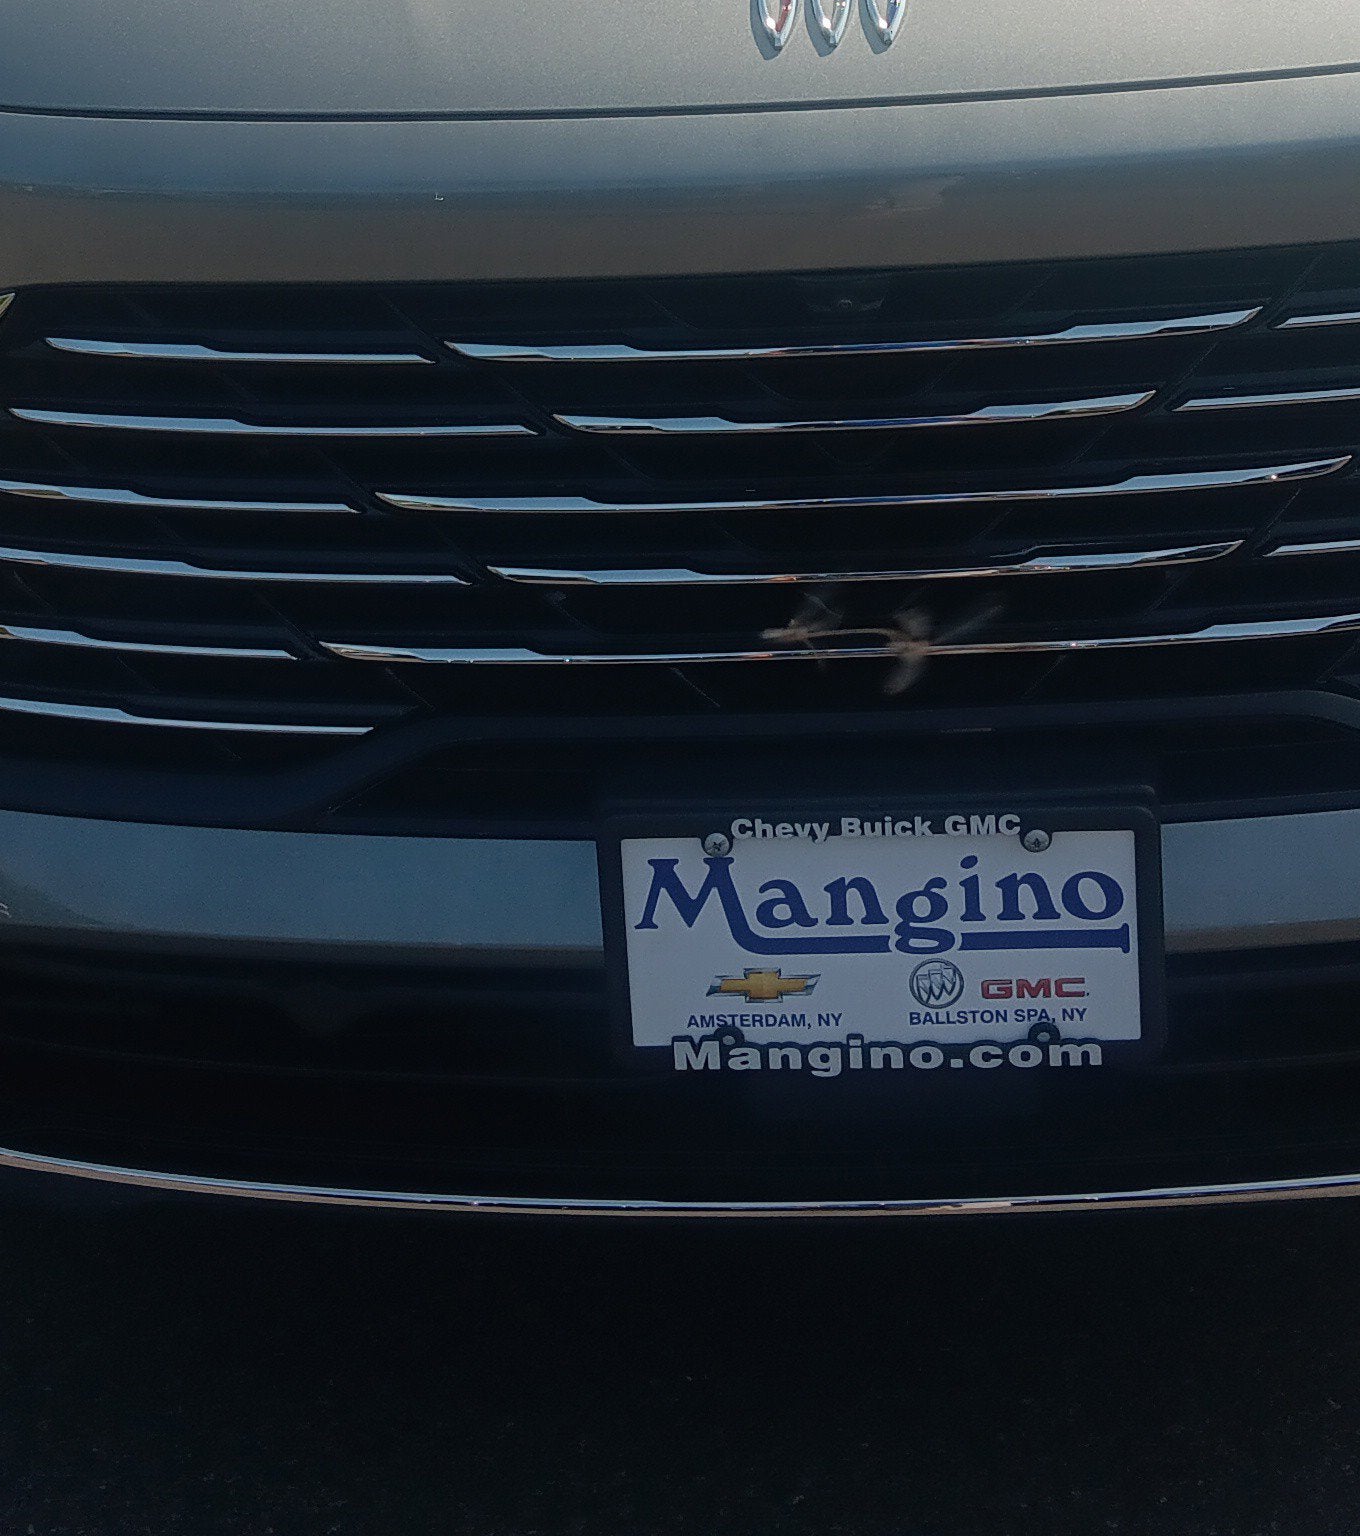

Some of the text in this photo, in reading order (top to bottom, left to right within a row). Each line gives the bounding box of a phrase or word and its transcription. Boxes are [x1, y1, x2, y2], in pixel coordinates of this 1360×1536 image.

[730, 814, 1021, 843] Chevy Buick GMC
[634, 854, 1130, 955] Mangino
[980, 977, 1086, 1000] GMC
[687, 1013, 843, 1030] AMSTERDAM, NY
[909, 1007, 1088, 1026] BALLSTON SPA, NY
[672, 1033, 1103, 1078] Mangino.com
